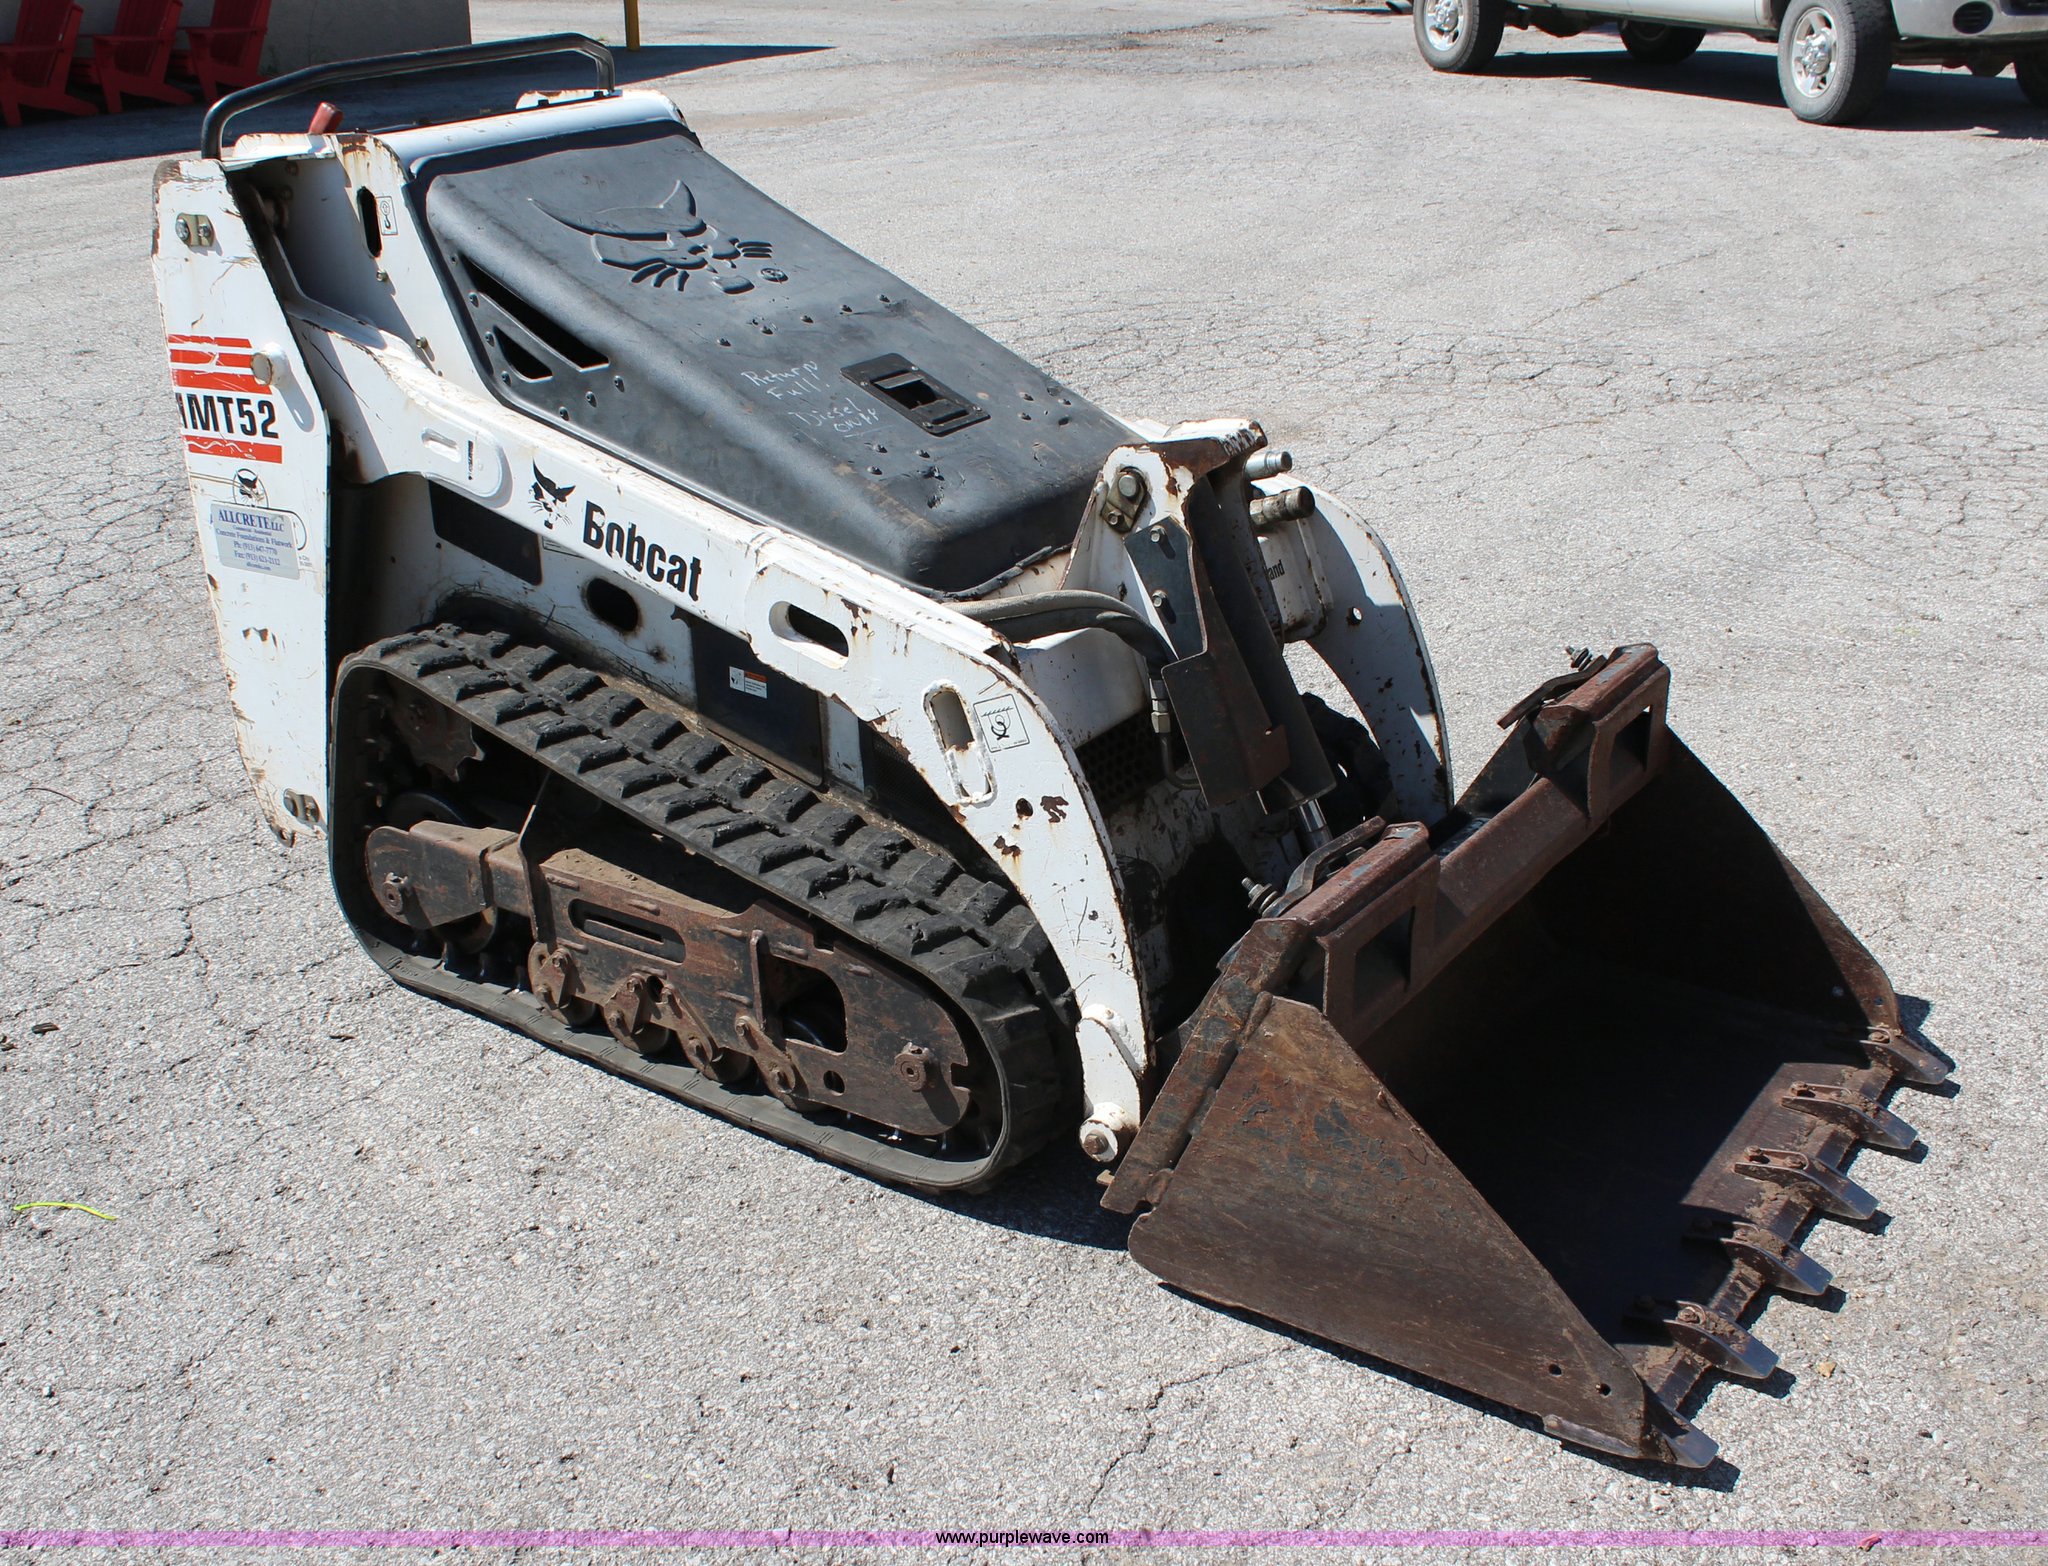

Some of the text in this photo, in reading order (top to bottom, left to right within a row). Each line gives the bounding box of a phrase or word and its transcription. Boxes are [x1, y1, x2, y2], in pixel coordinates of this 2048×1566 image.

[741, 360, 818, 387] Return
[787, 397, 862, 427] Diesel
[218, 509, 272, 530] ALLCRETE
[271, 521, 284, 532] LLC
[583, 500, 702, 602] Bobcat
